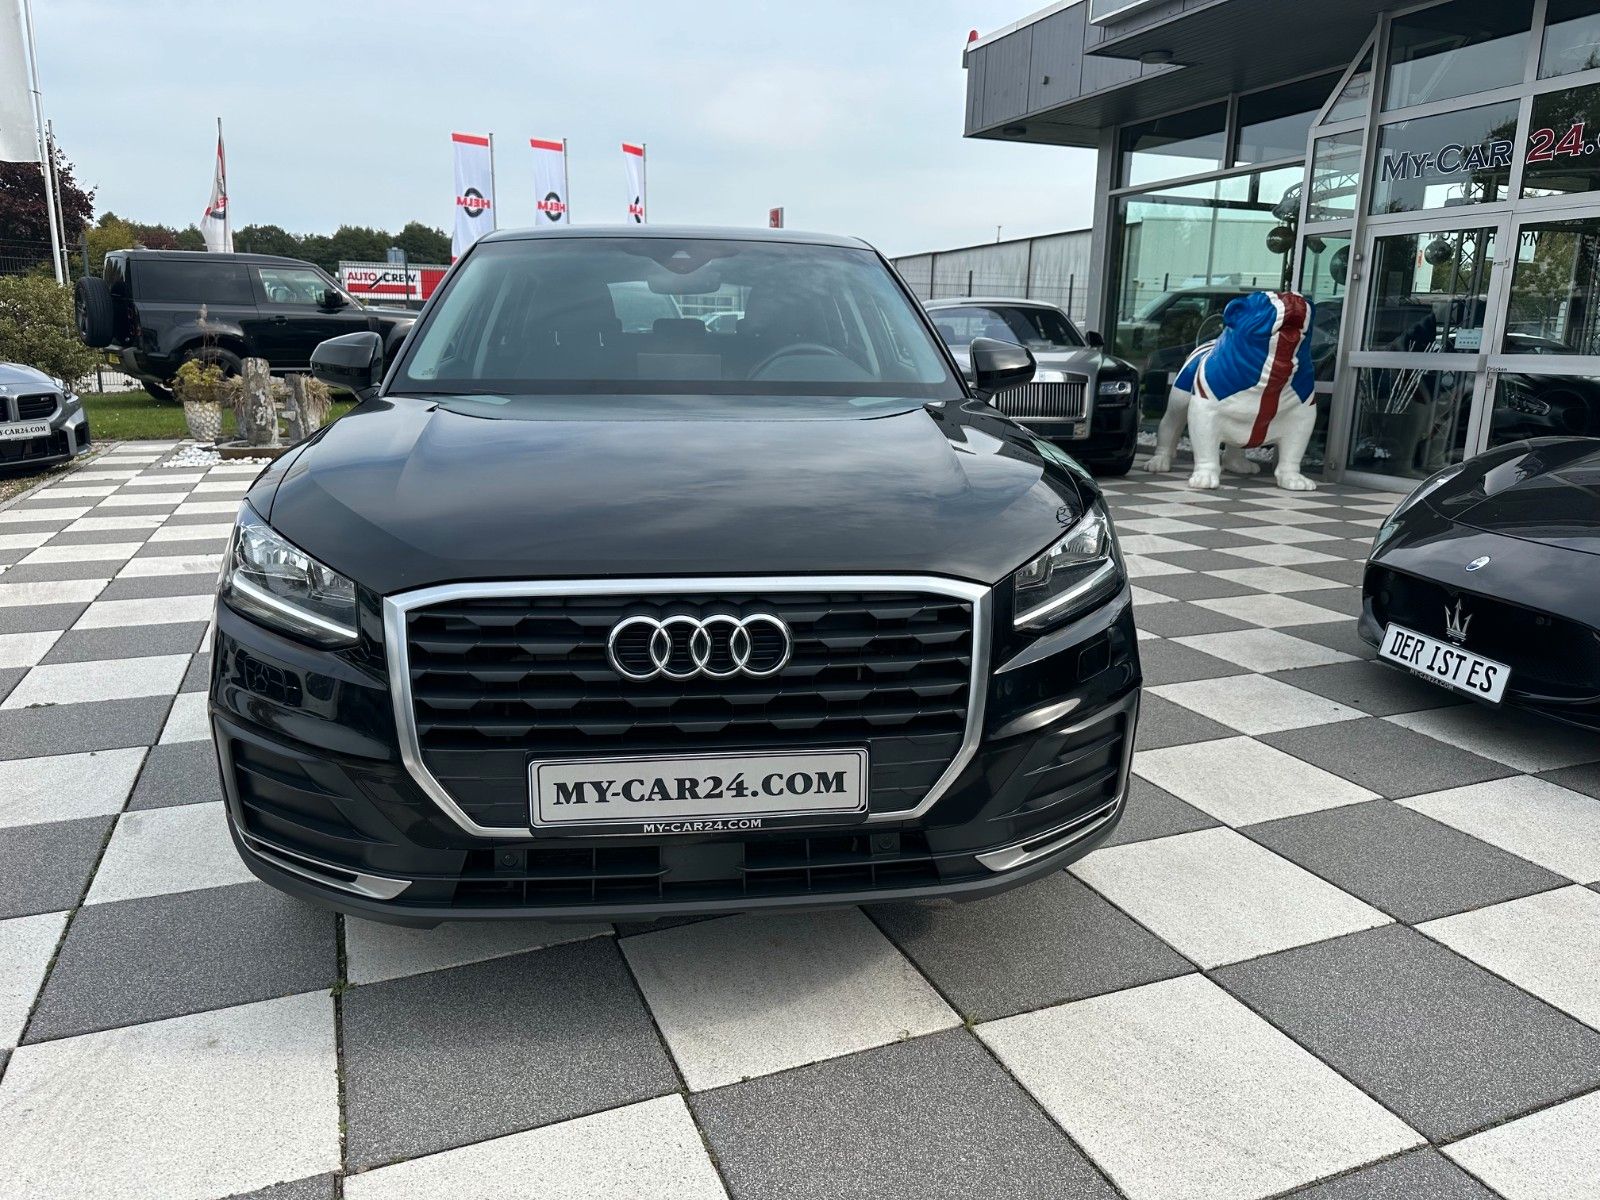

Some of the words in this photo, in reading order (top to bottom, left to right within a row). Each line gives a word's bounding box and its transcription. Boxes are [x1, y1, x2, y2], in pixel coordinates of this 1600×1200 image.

[347, 272, 377, 281] AUTO
[383, 272, 416, 283] CREW
[1389, 631, 1425, 665] DER
[1426, 645, 1467, 680] IST
[1465, 660, 1498, 693] ES
[552, 770, 848, 806] MY-CAR24.COM
[643, 818, 763, 834] MY-CAR24.COM
